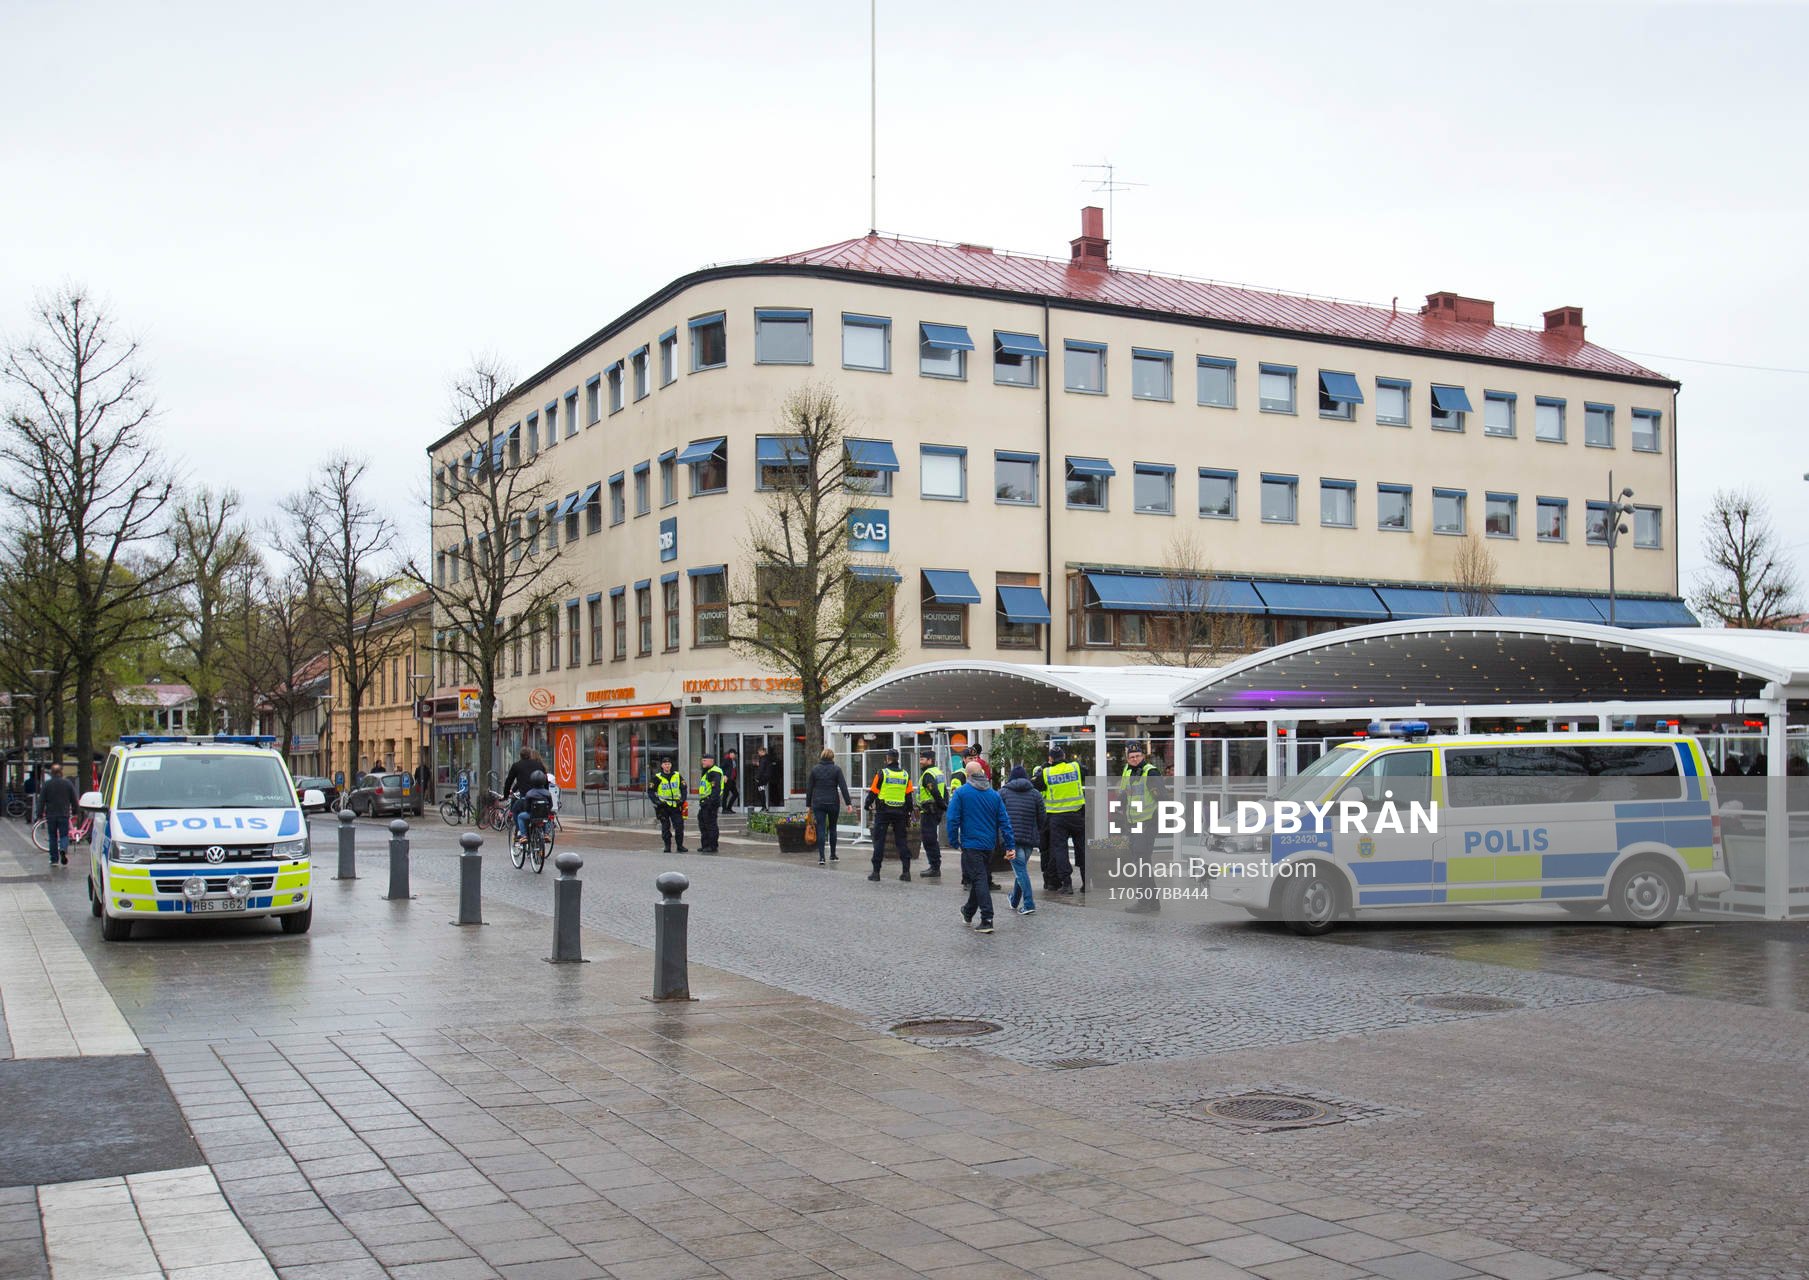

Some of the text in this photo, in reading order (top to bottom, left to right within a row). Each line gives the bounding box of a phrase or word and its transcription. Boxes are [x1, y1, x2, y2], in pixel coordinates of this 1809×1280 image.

[683, 678, 745, 693] HOLMQUIST
[1050, 772, 1078, 784] POLIS
[154, 817, 269, 832] POLIS
[1280, 834, 1318, 845] 23-2420
[1464, 828, 1549, 854] POLIS
[193, 900, 243, 911] HBS 662
